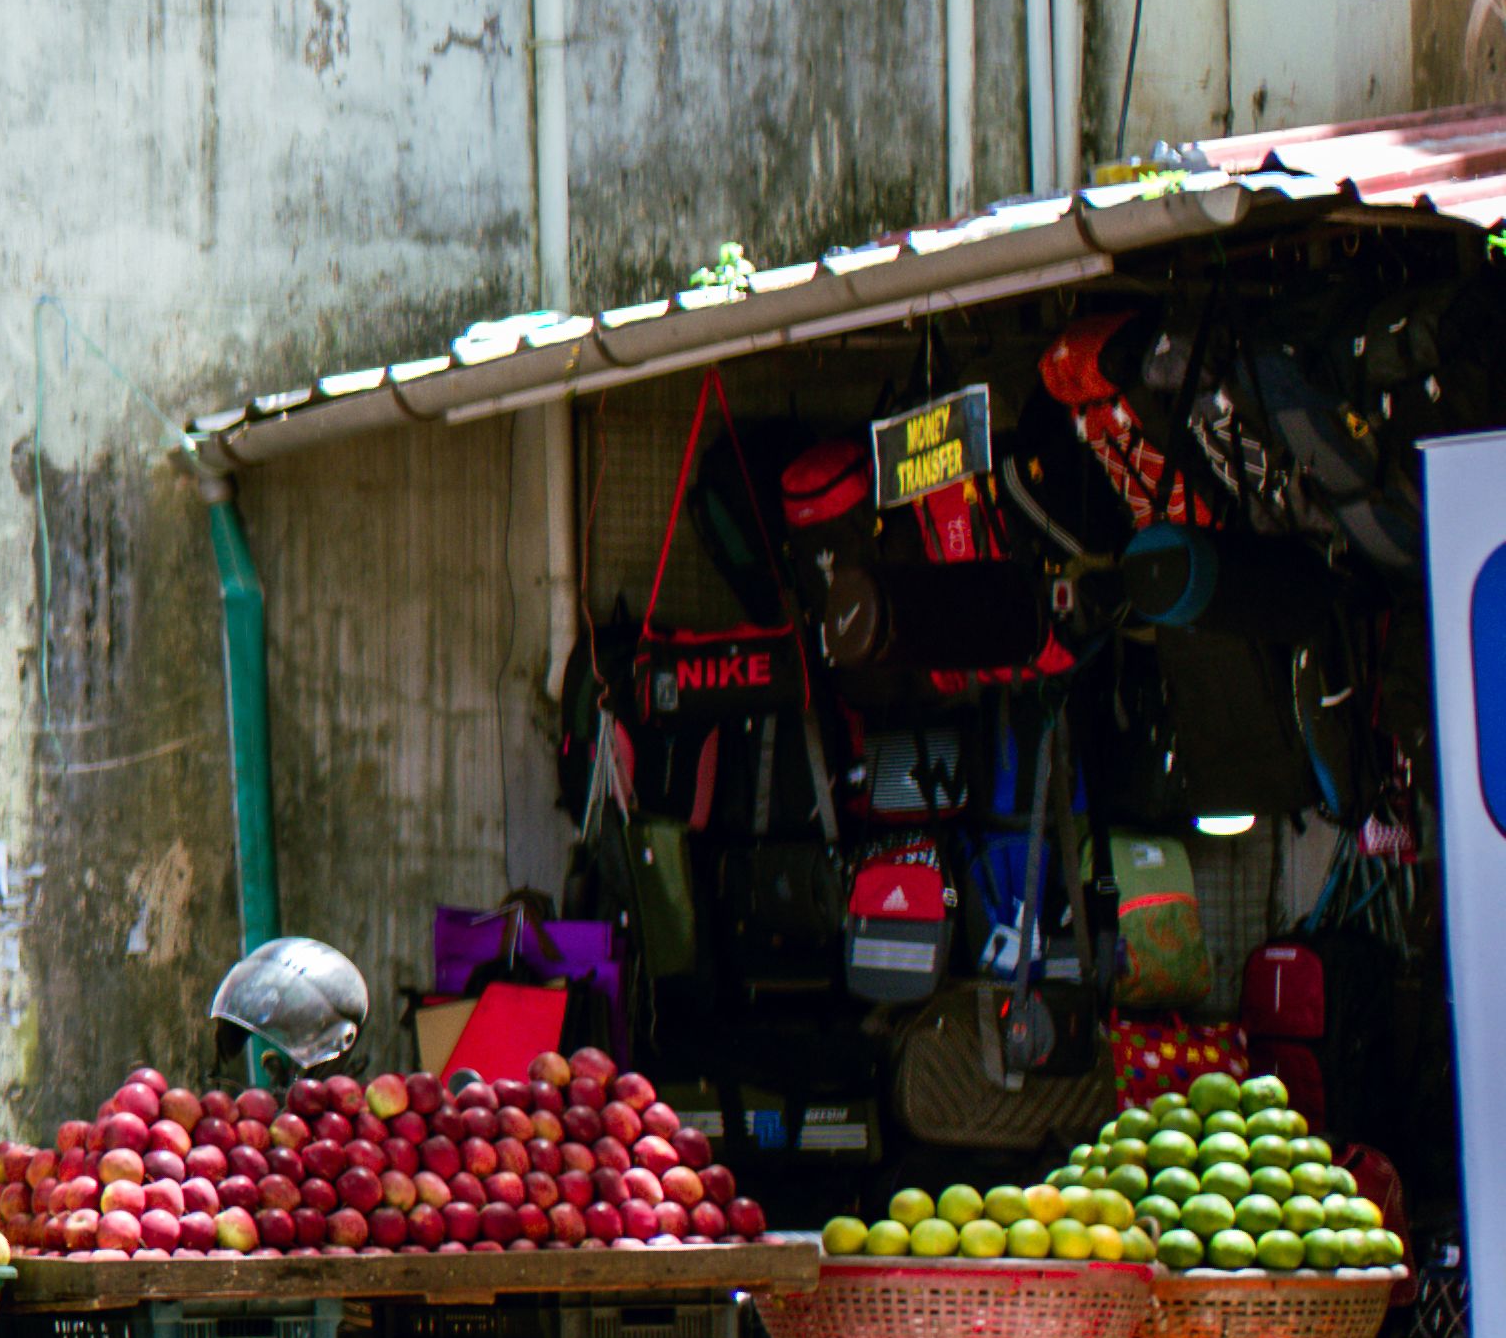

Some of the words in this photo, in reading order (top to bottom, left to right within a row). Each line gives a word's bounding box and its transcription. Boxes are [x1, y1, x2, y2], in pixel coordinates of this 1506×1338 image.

[906, 404, 951, 456] MONEY
[896, 438, 964, 498] TRANSFER
[676, 652, 772, 692] NIKE
